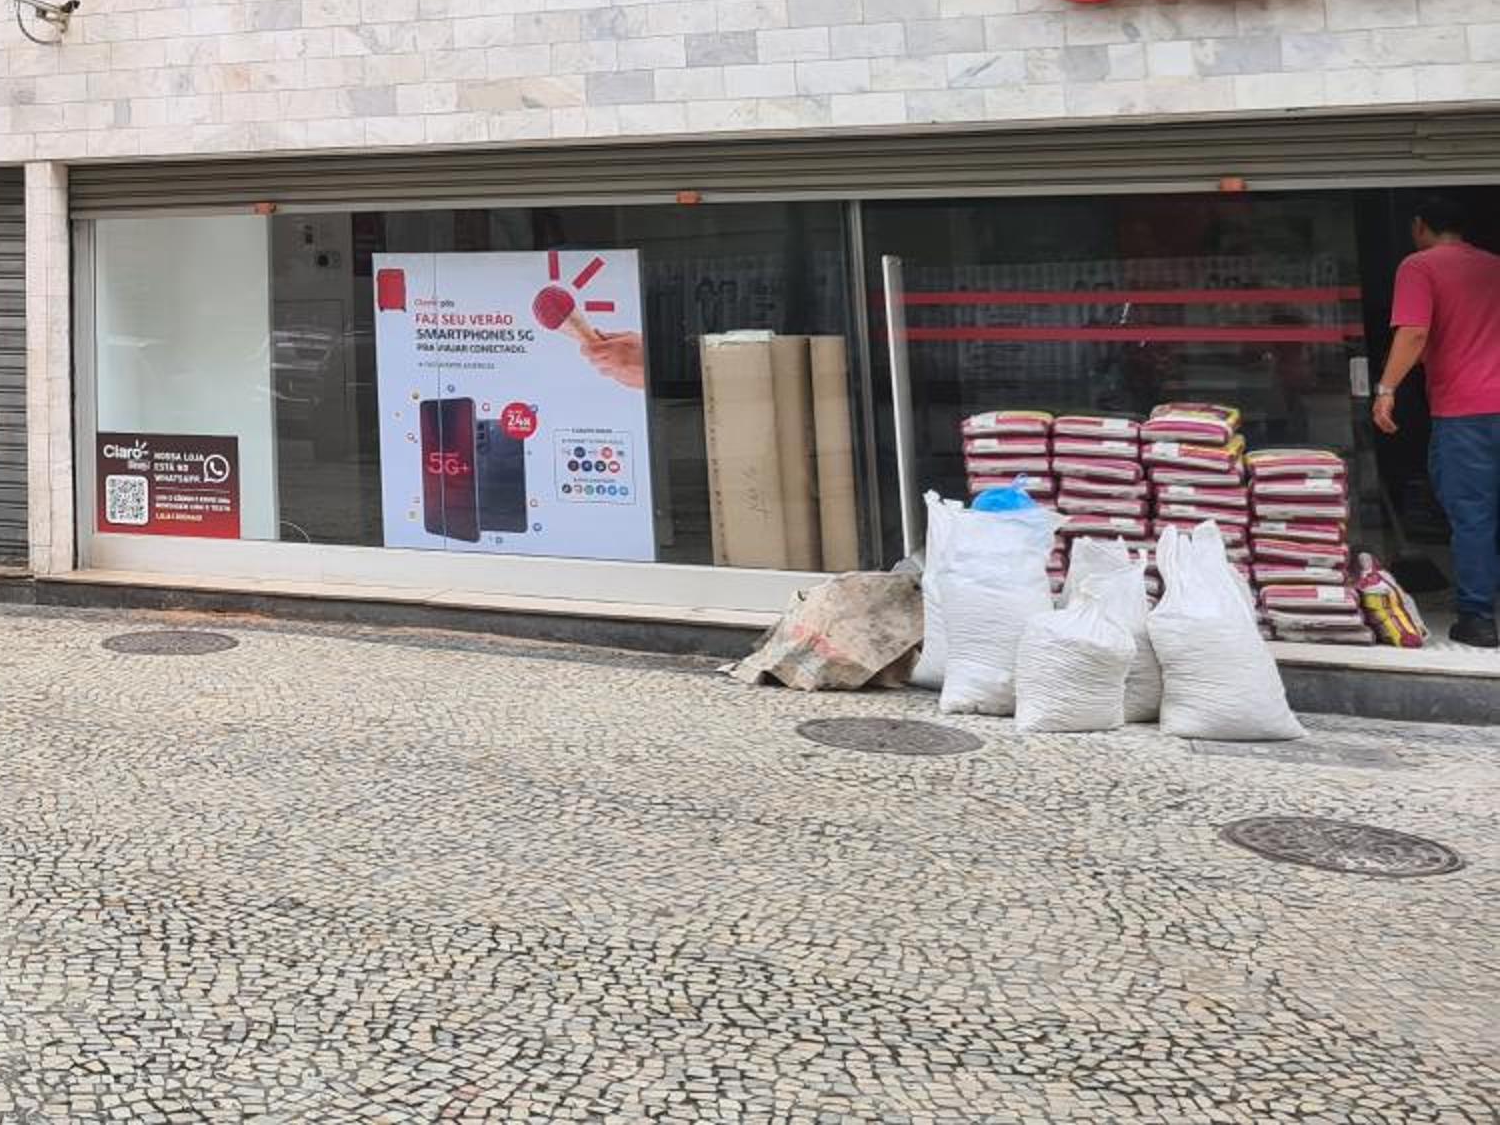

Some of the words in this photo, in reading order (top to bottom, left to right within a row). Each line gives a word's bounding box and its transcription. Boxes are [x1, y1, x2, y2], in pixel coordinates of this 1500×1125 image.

[415, 313, 438, 325] FAZ
[440, 314, 466, 326] SEU
[469, 310, 514, 326] VERÃO
[416, 328, 515, 342] SMARTPHONES
[517, 329, 535, 342] 5G
[103, 444, 143, 460] Claro
